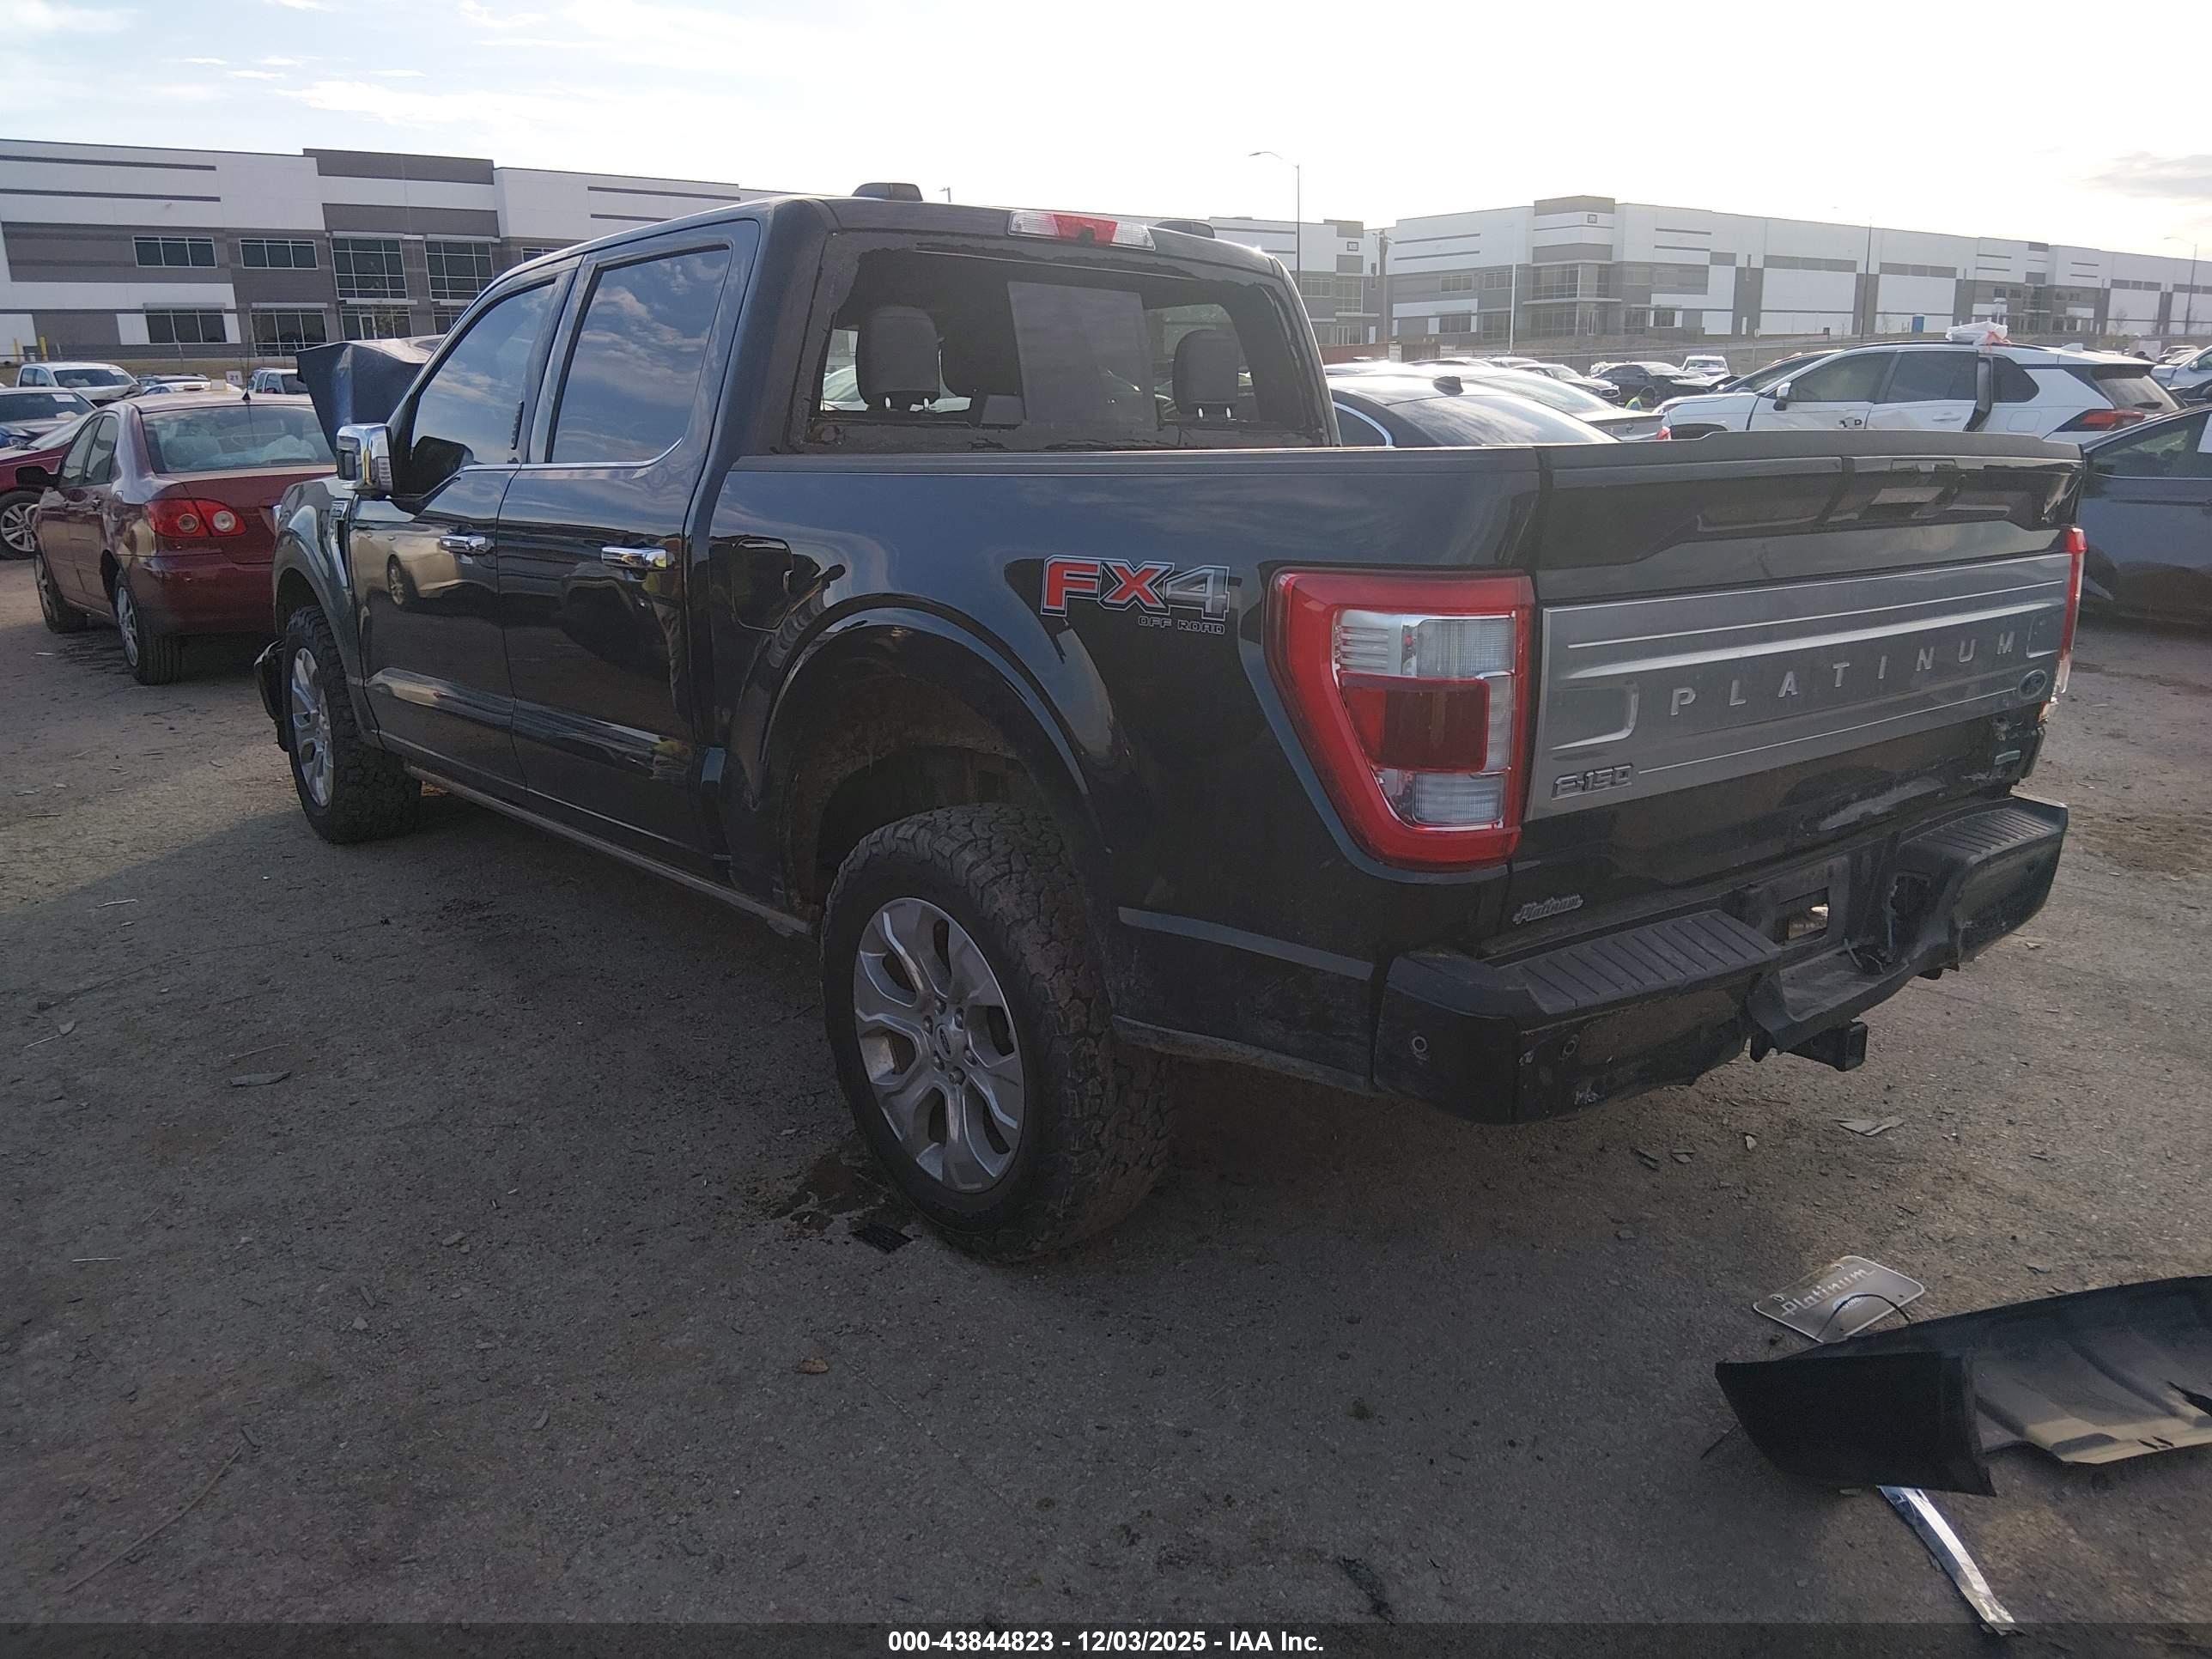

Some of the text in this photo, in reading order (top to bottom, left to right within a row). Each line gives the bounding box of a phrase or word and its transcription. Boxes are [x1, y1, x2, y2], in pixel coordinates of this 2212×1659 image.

[1040, 554, 1231, 622] FX4
[1138, 616, 1225, 635] OFF ROAD
[1670, 631, 2015, 716] PLATINUM
[1552, 763, 1633, 799] F-150
[1780, 1267, 1877, 1317] Platinum
